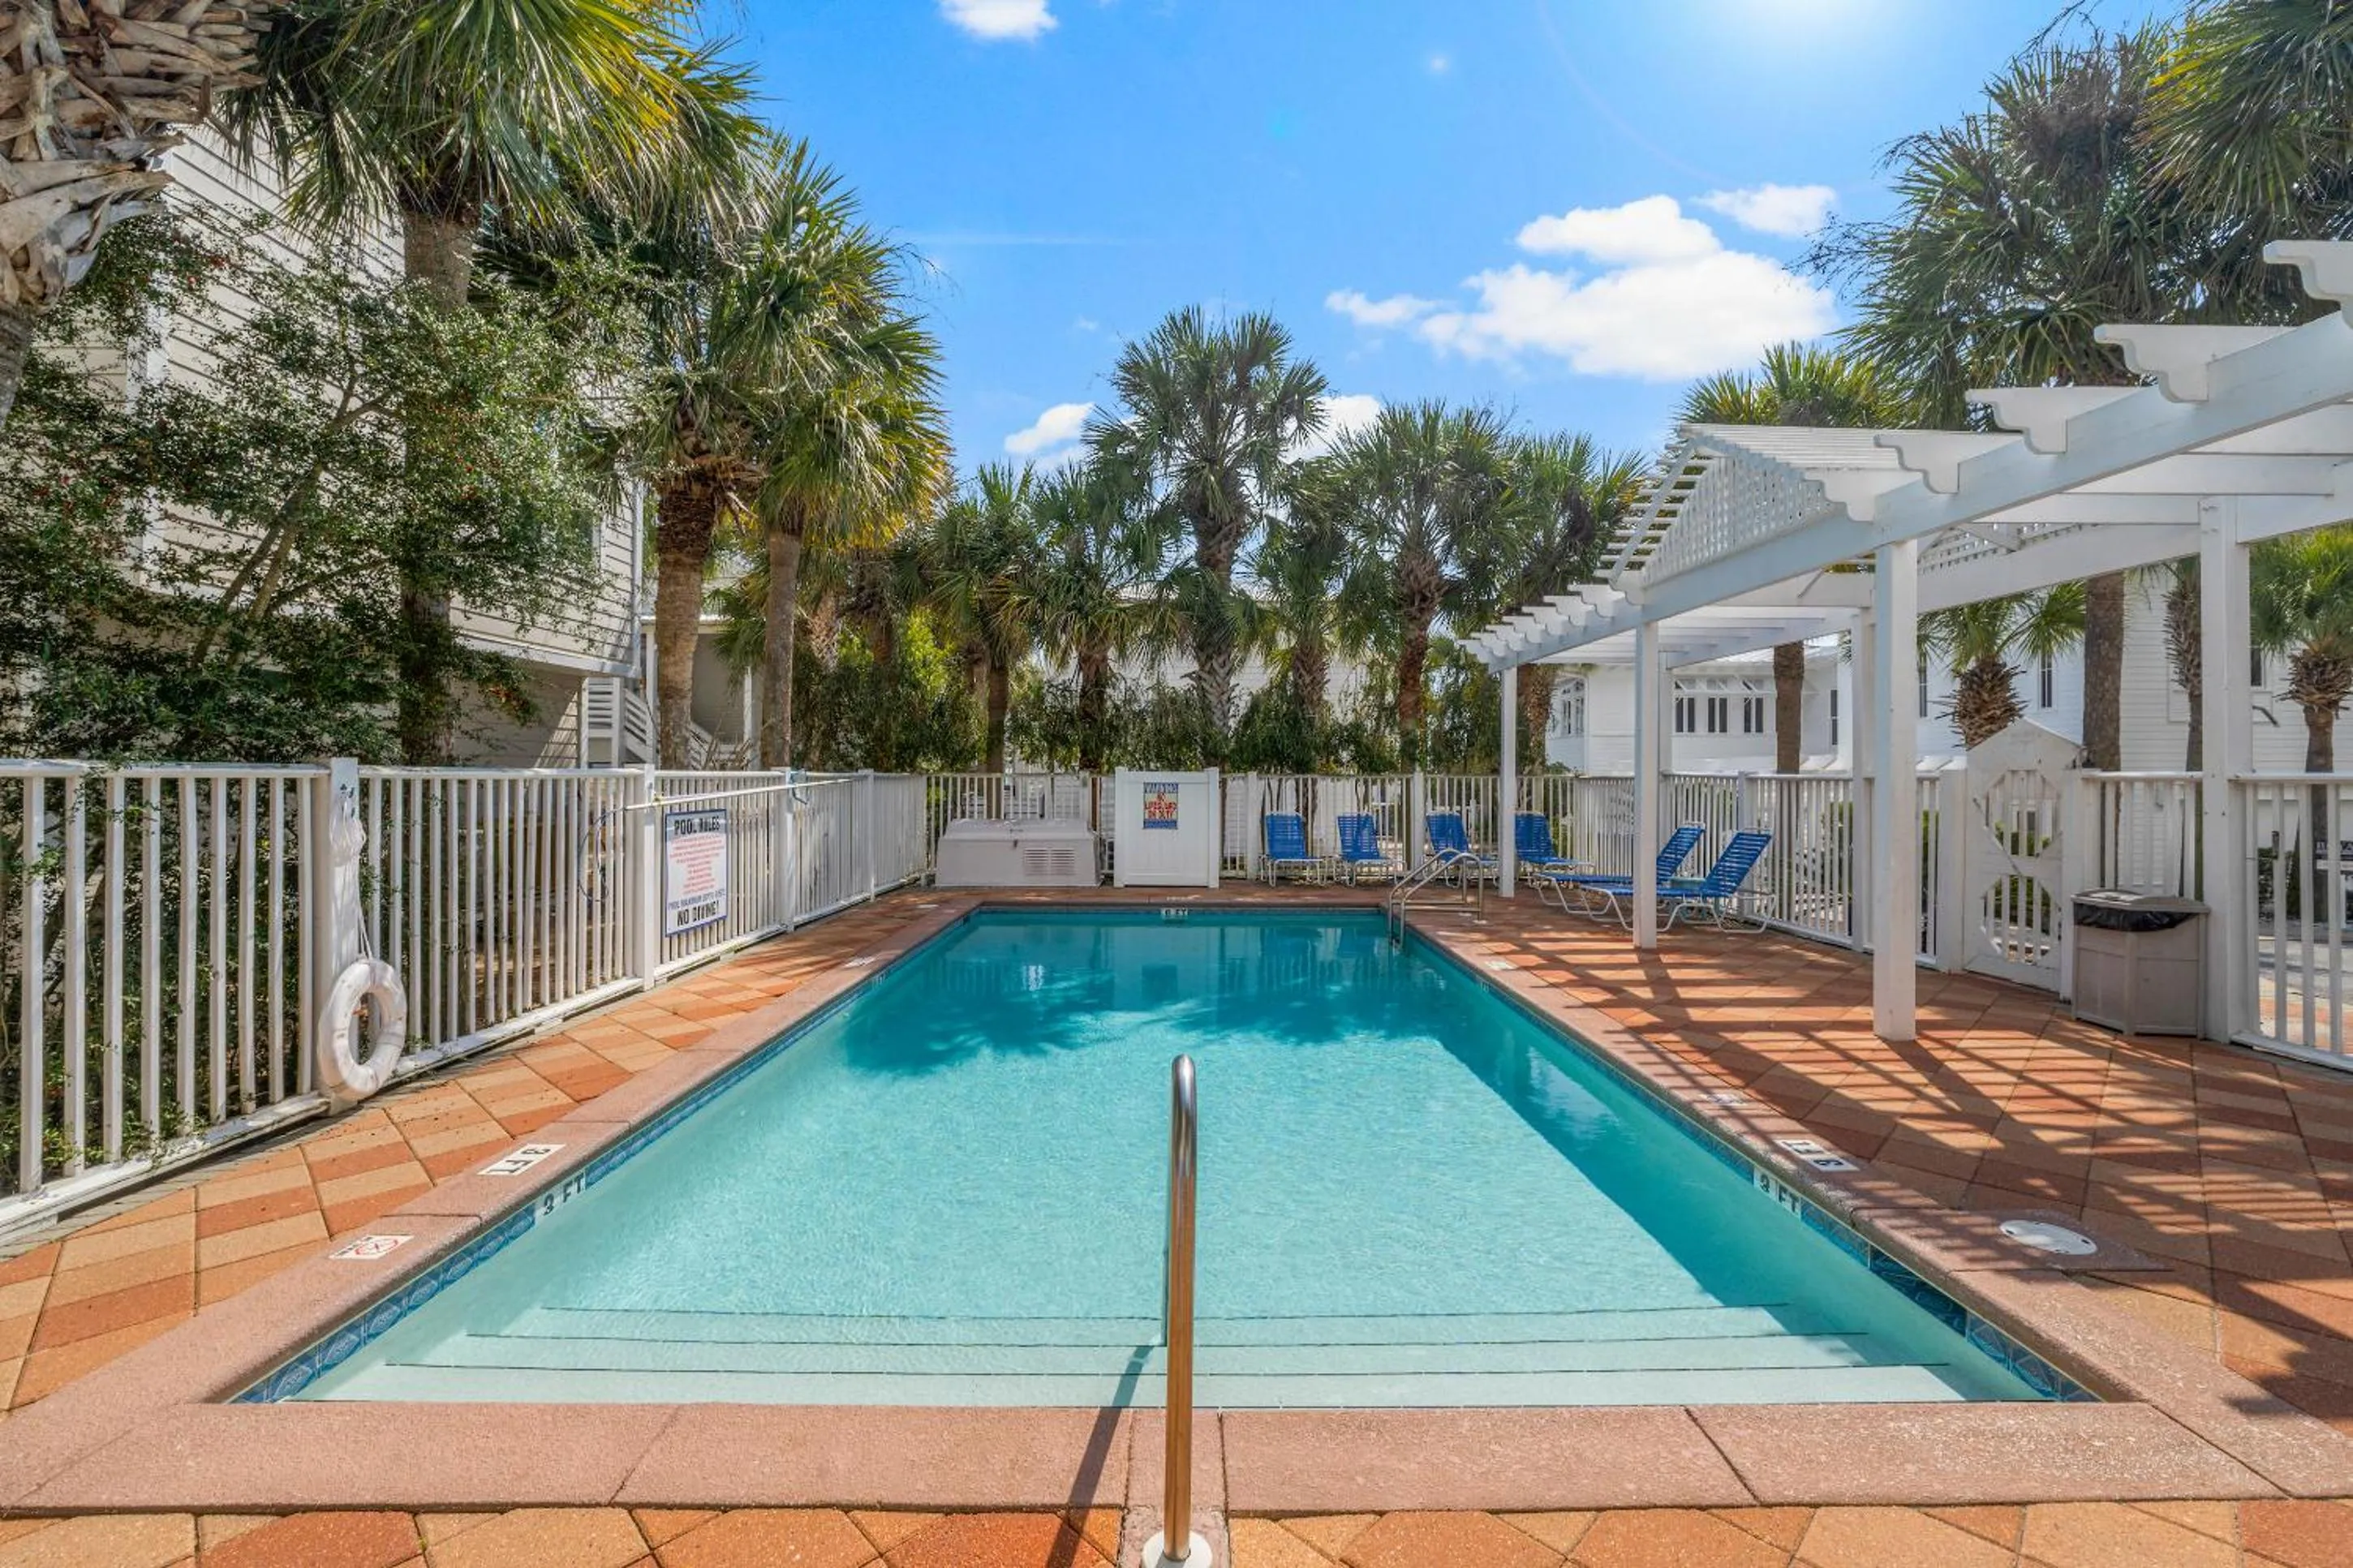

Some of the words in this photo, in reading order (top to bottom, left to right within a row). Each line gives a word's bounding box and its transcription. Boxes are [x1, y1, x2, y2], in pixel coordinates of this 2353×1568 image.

[674, 818, 697, 836] POOL
[699, 815, 721, 832] RULES
[677, 909, 690, 926] NO
[487, 1159, 532, 1174] FT
[542, 1193, 555, 1216] 3
[562, 1172, 586, 1203] FT
[1759, 1174, 1771, 1193] 3
[1778, 1184, 1800, 1214] FT
